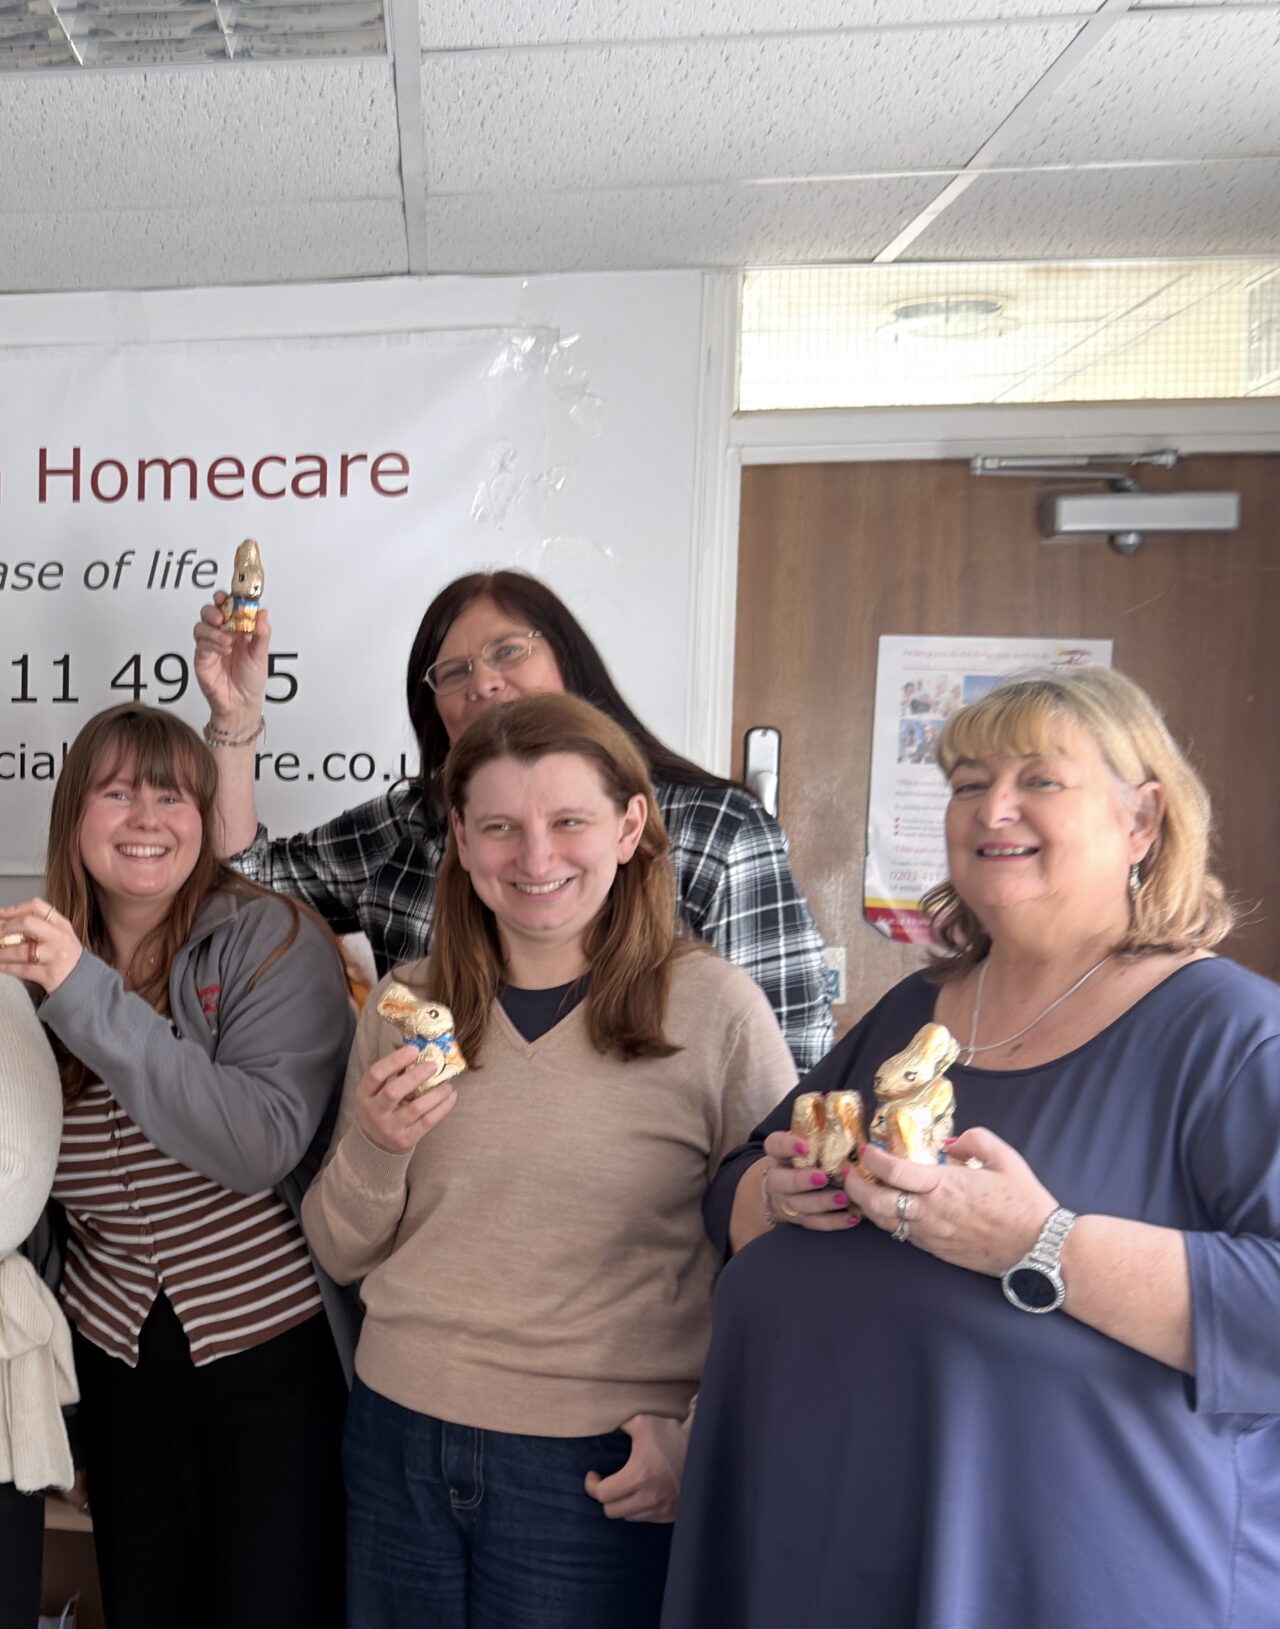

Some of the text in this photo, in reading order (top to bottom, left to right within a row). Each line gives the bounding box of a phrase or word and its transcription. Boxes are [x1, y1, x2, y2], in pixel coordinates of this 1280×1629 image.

[37, 446, 410, 504] Homecare
[82, 549, 136, 590] of
[146, 548, 218, 590] life
